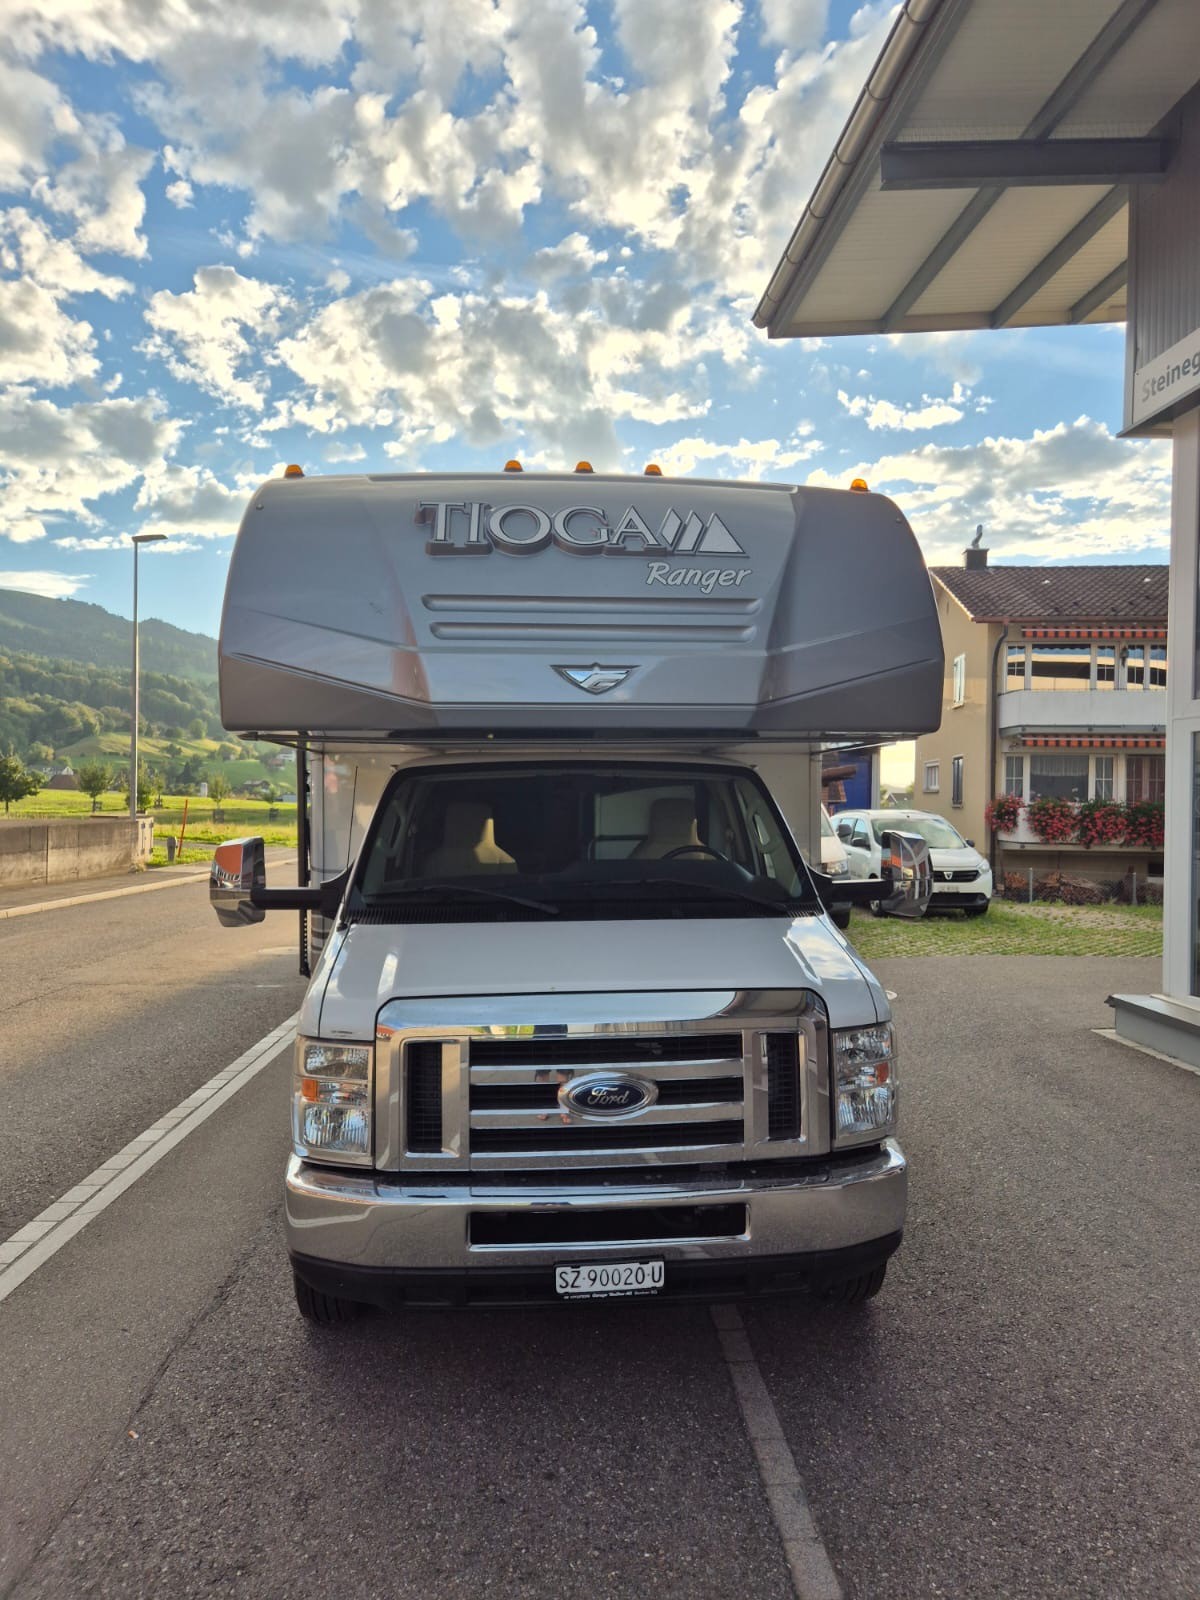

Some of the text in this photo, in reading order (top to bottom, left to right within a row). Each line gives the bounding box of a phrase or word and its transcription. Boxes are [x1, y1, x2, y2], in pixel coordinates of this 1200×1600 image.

[418, 501, 664, 552] TIOGA
[646, 561, 752, 594] Ranger
[587, 1086, 629, 1105] Ford
